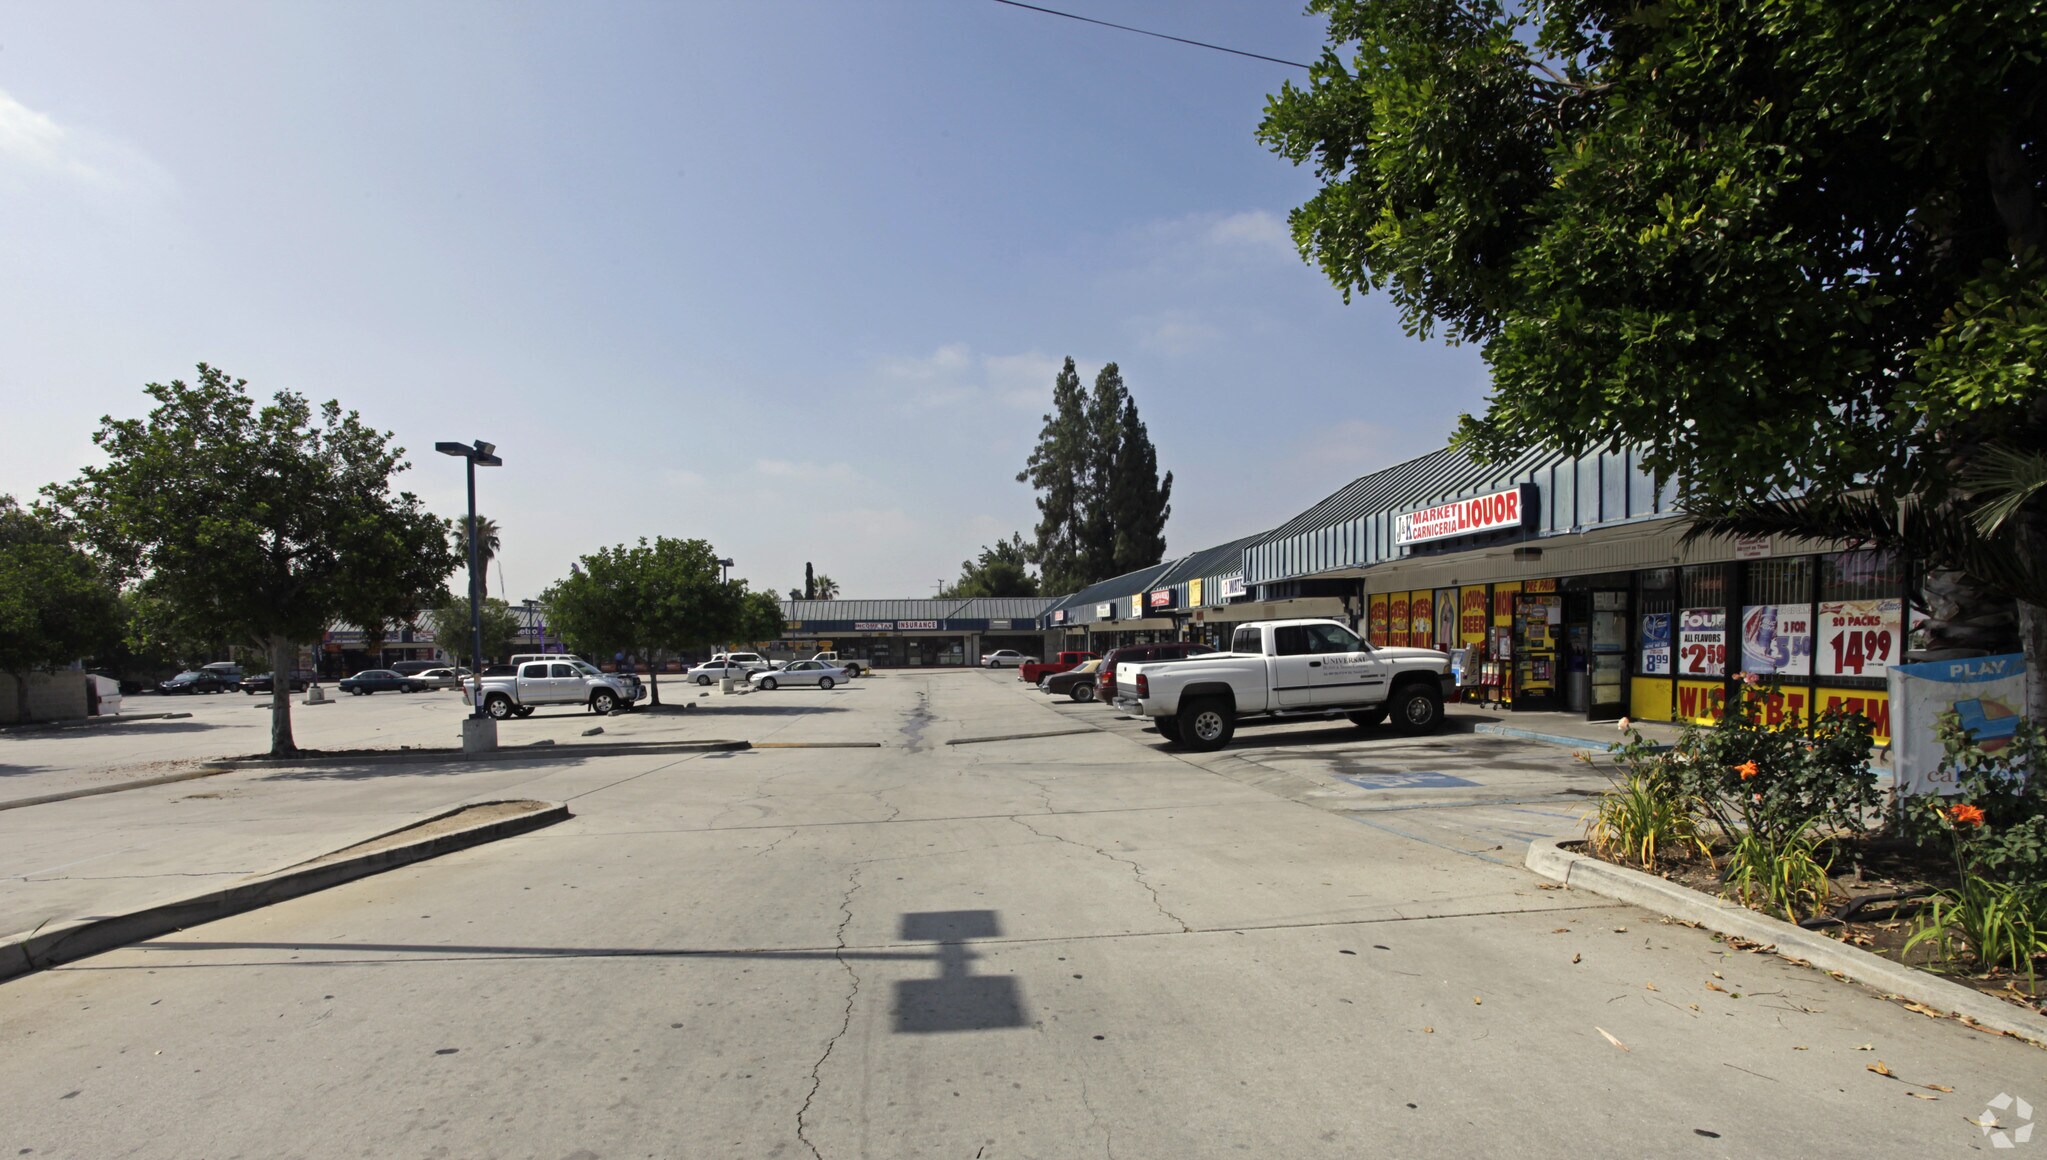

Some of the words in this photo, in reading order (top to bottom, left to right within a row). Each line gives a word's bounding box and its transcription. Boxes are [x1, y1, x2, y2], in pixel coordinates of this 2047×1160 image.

[1412, 504, 1457, 525] MARKET
[1457, 491, 1518, 530] LIQUOR
[1396, 515, 1413, 543] J&K
[1413, 519, 1457, 540] CARNICERIA
[1390, 599, 1409, 622] FRESH
[1412, 598, 1432, 622] FRESH
[1680, 611, 1725, 627] four
[1463, 615, 1485, 634] BEER
[1784, 621, 1789, 633] 3
[1790, 621, 1806, 633] FOR
[1833, 617, 1845, 627] 20
[1848, 616, 1881, 626] PACKS
[1684, 634, 1694, 642] ALL
[1695, 633, 1721, 642] FLAVORS
[1323, 656, 1367, 665] UNIVERSAL
[1951, 660, 2006, 677] PLAY
